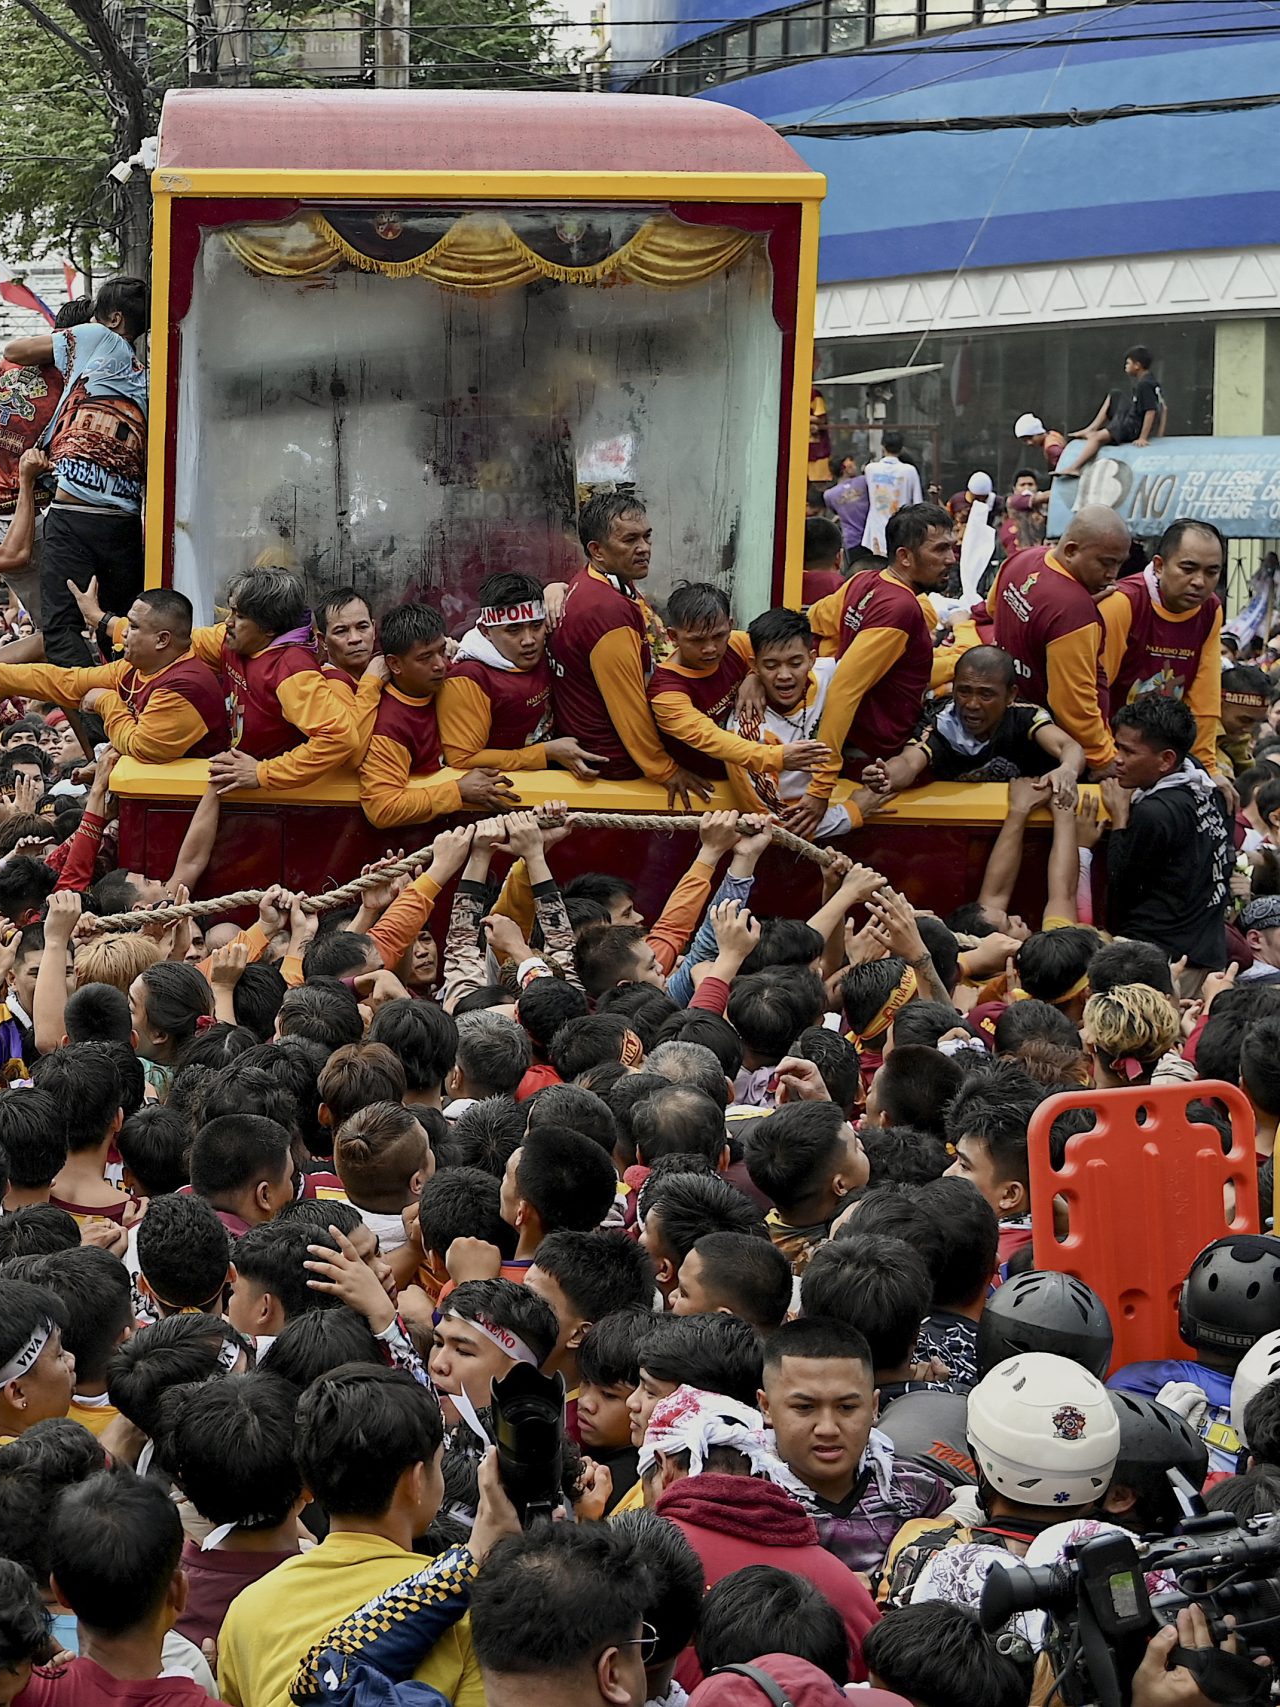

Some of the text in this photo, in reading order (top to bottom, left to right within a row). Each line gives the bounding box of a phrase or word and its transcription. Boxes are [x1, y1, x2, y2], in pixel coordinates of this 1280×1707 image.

[1184, 471, 1206, 486] TO
[1207, 470, 1267, 486] ILLEGAL
[1129, 474, 1177, 520] NO
[1181, 485, 1198, 500] TO
[1199, 485, 1258, 500] ILLEGAL
[1175, 501, 1253, 519] LITTERING
[1225, 692, 1262, 706] BATANG
[891, 986, 909, 1010] VIVA
[1196, 1328, 1250, 1347] MEMBER
[16, 1338, 42, 1368] VIVA
